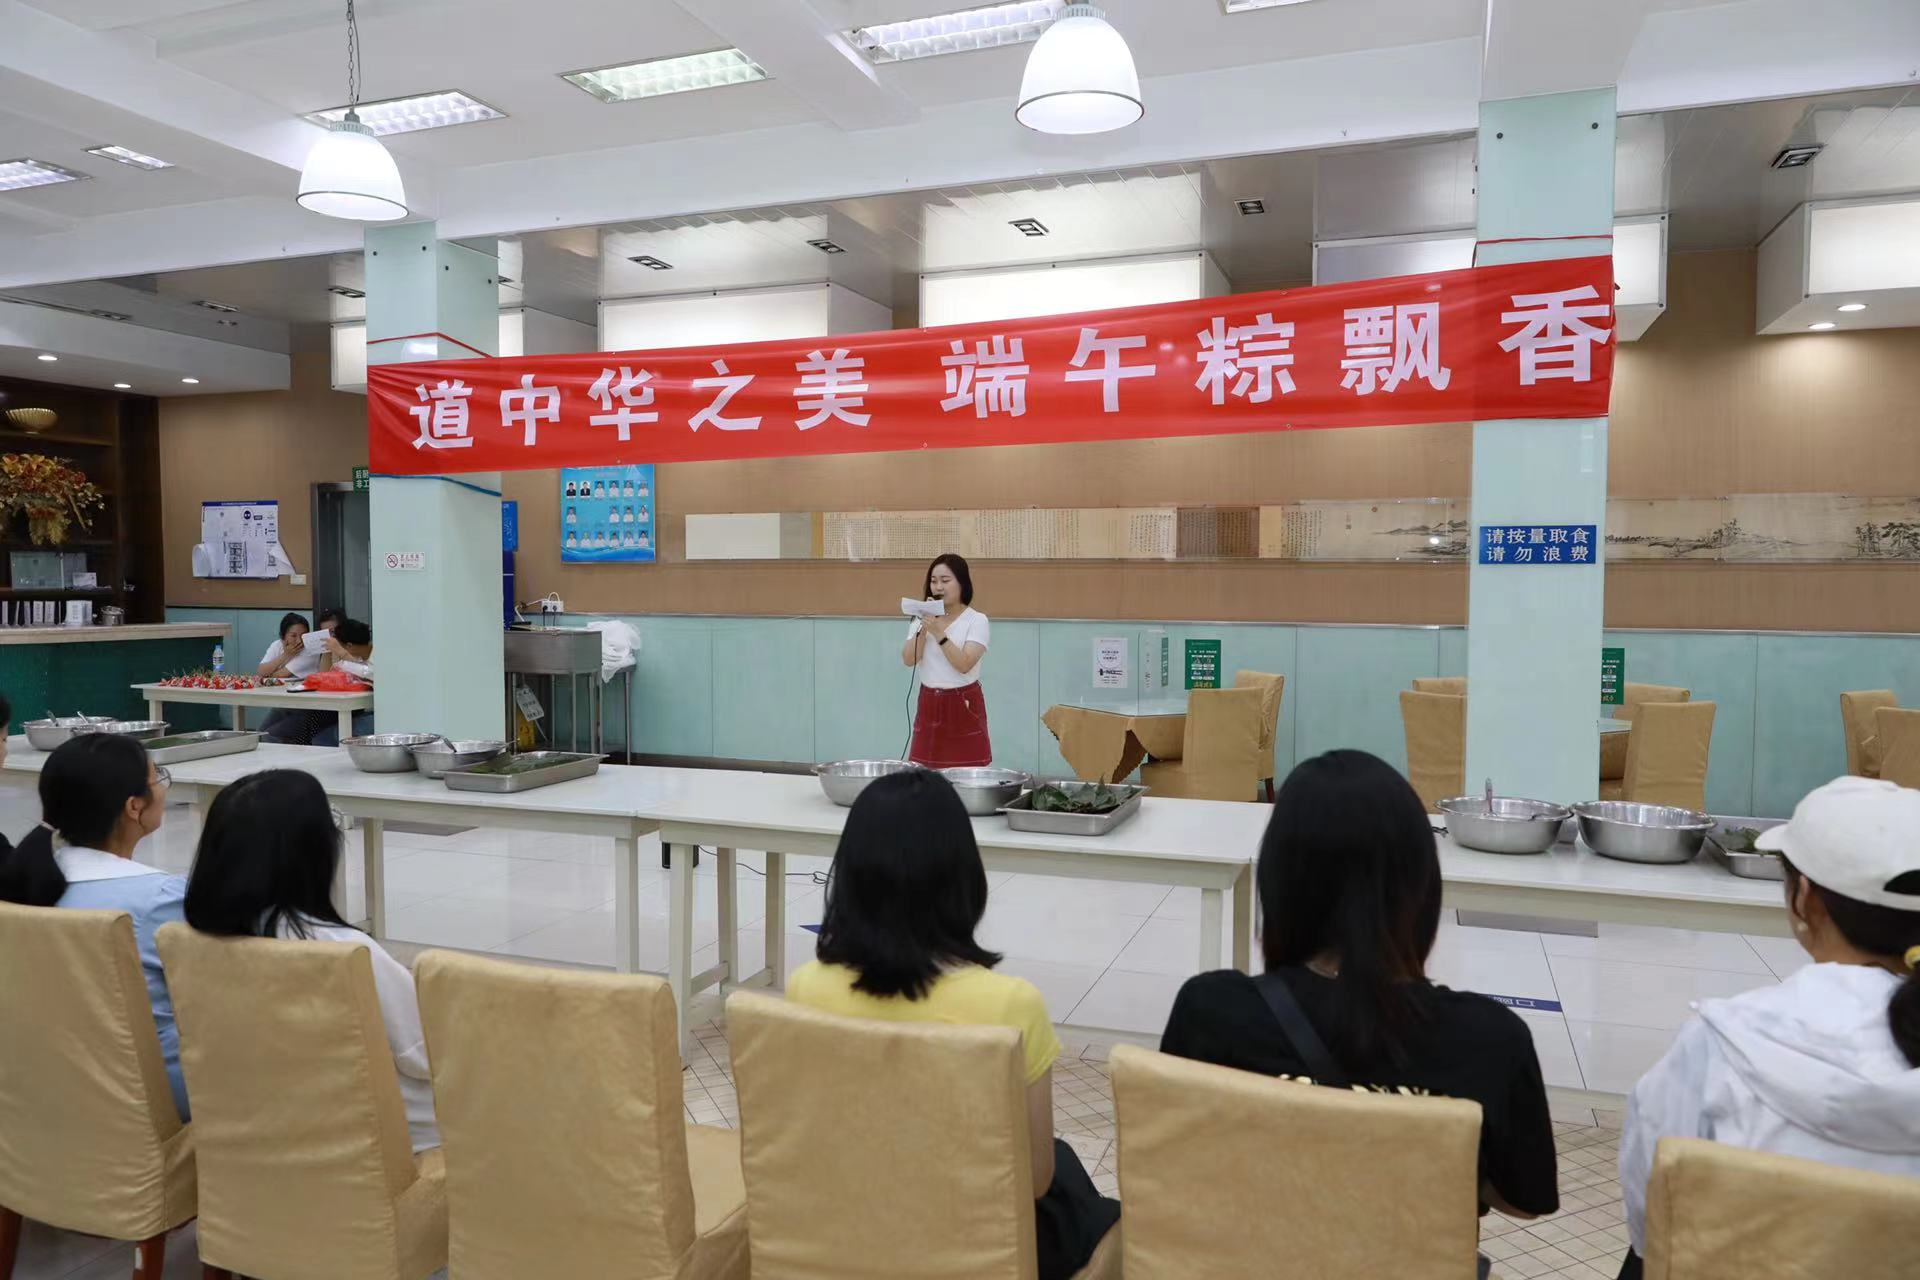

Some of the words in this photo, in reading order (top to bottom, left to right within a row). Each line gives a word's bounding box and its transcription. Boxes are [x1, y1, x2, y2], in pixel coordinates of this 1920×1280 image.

[410, 348, 872, 450] 道中华之美
[940, 285, 1611, 418] 端午粽飘香
[1486, 527, 1590, 544] 请按量取食
[1486, 546, 1589, 562] 请勿浪费
